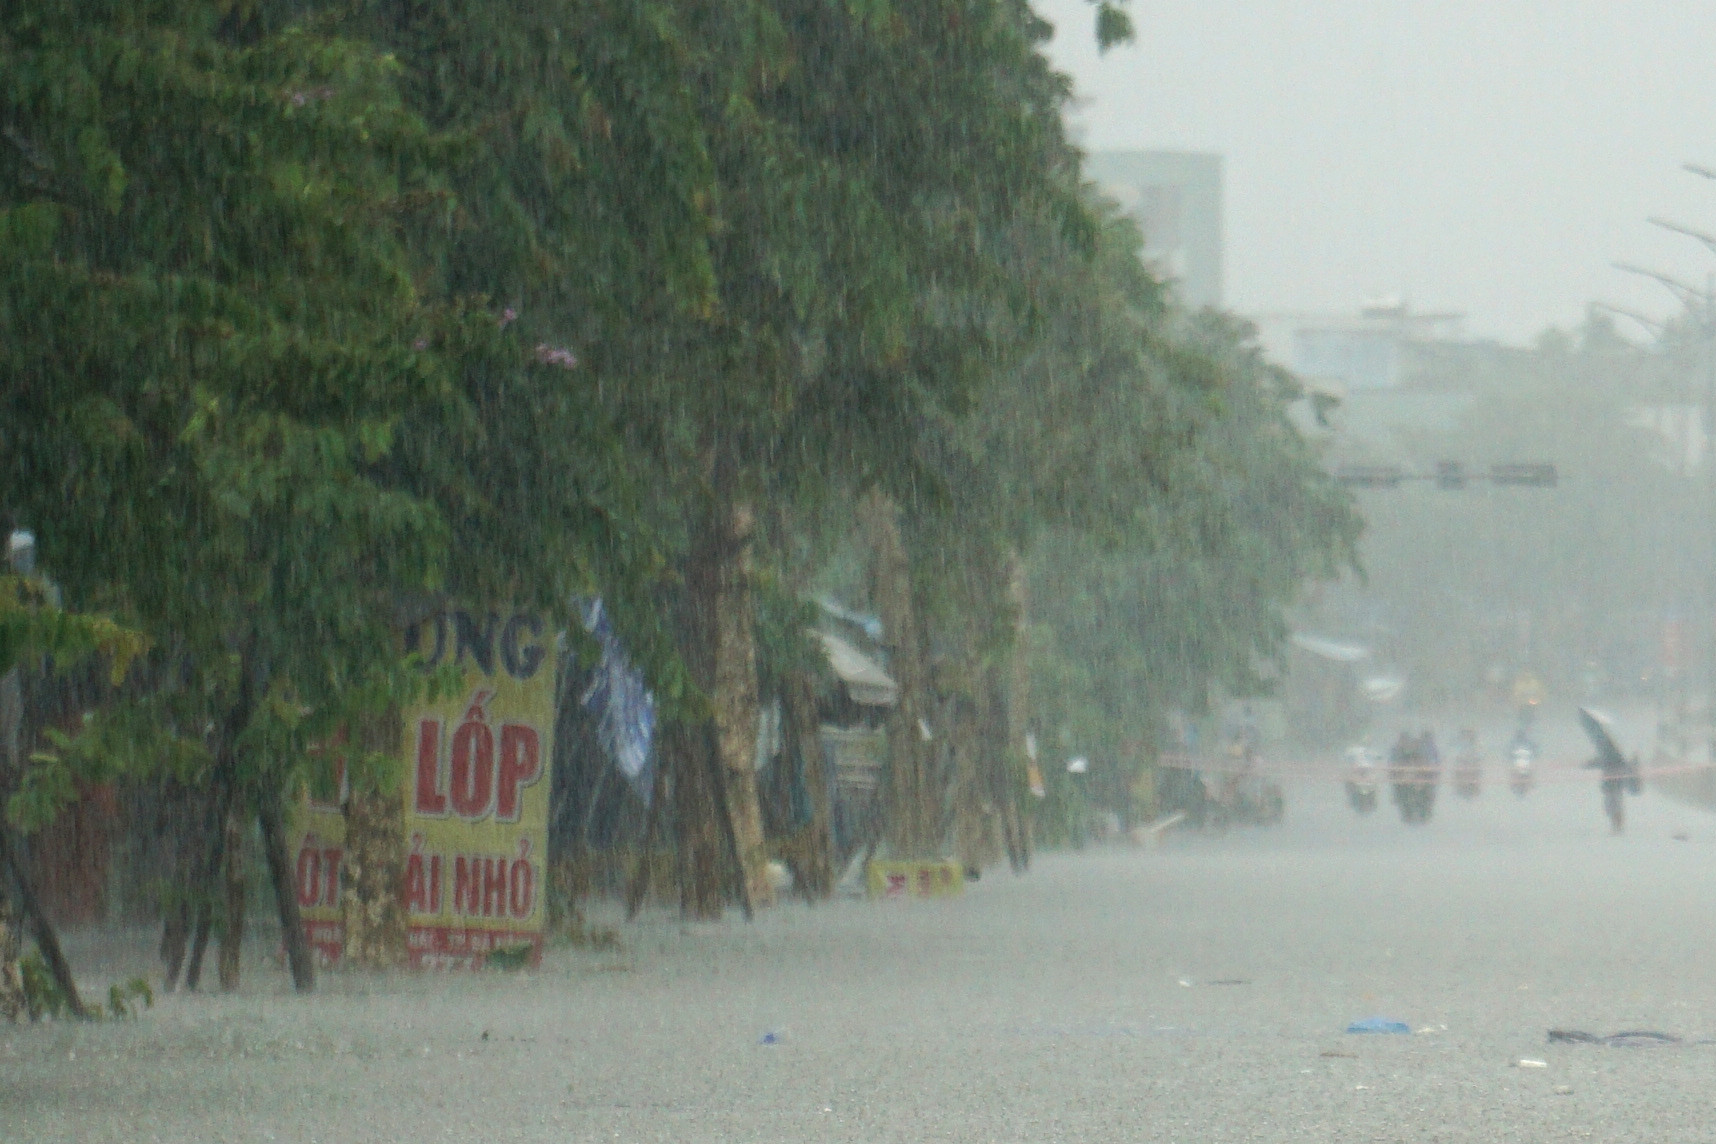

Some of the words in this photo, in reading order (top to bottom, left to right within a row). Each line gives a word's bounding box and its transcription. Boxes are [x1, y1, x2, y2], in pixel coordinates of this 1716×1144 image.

[414, 688, 543, 821] LỐP
[404, 832, 442, 915] ẢI
[454, 837, 533, 919] NHỎ
